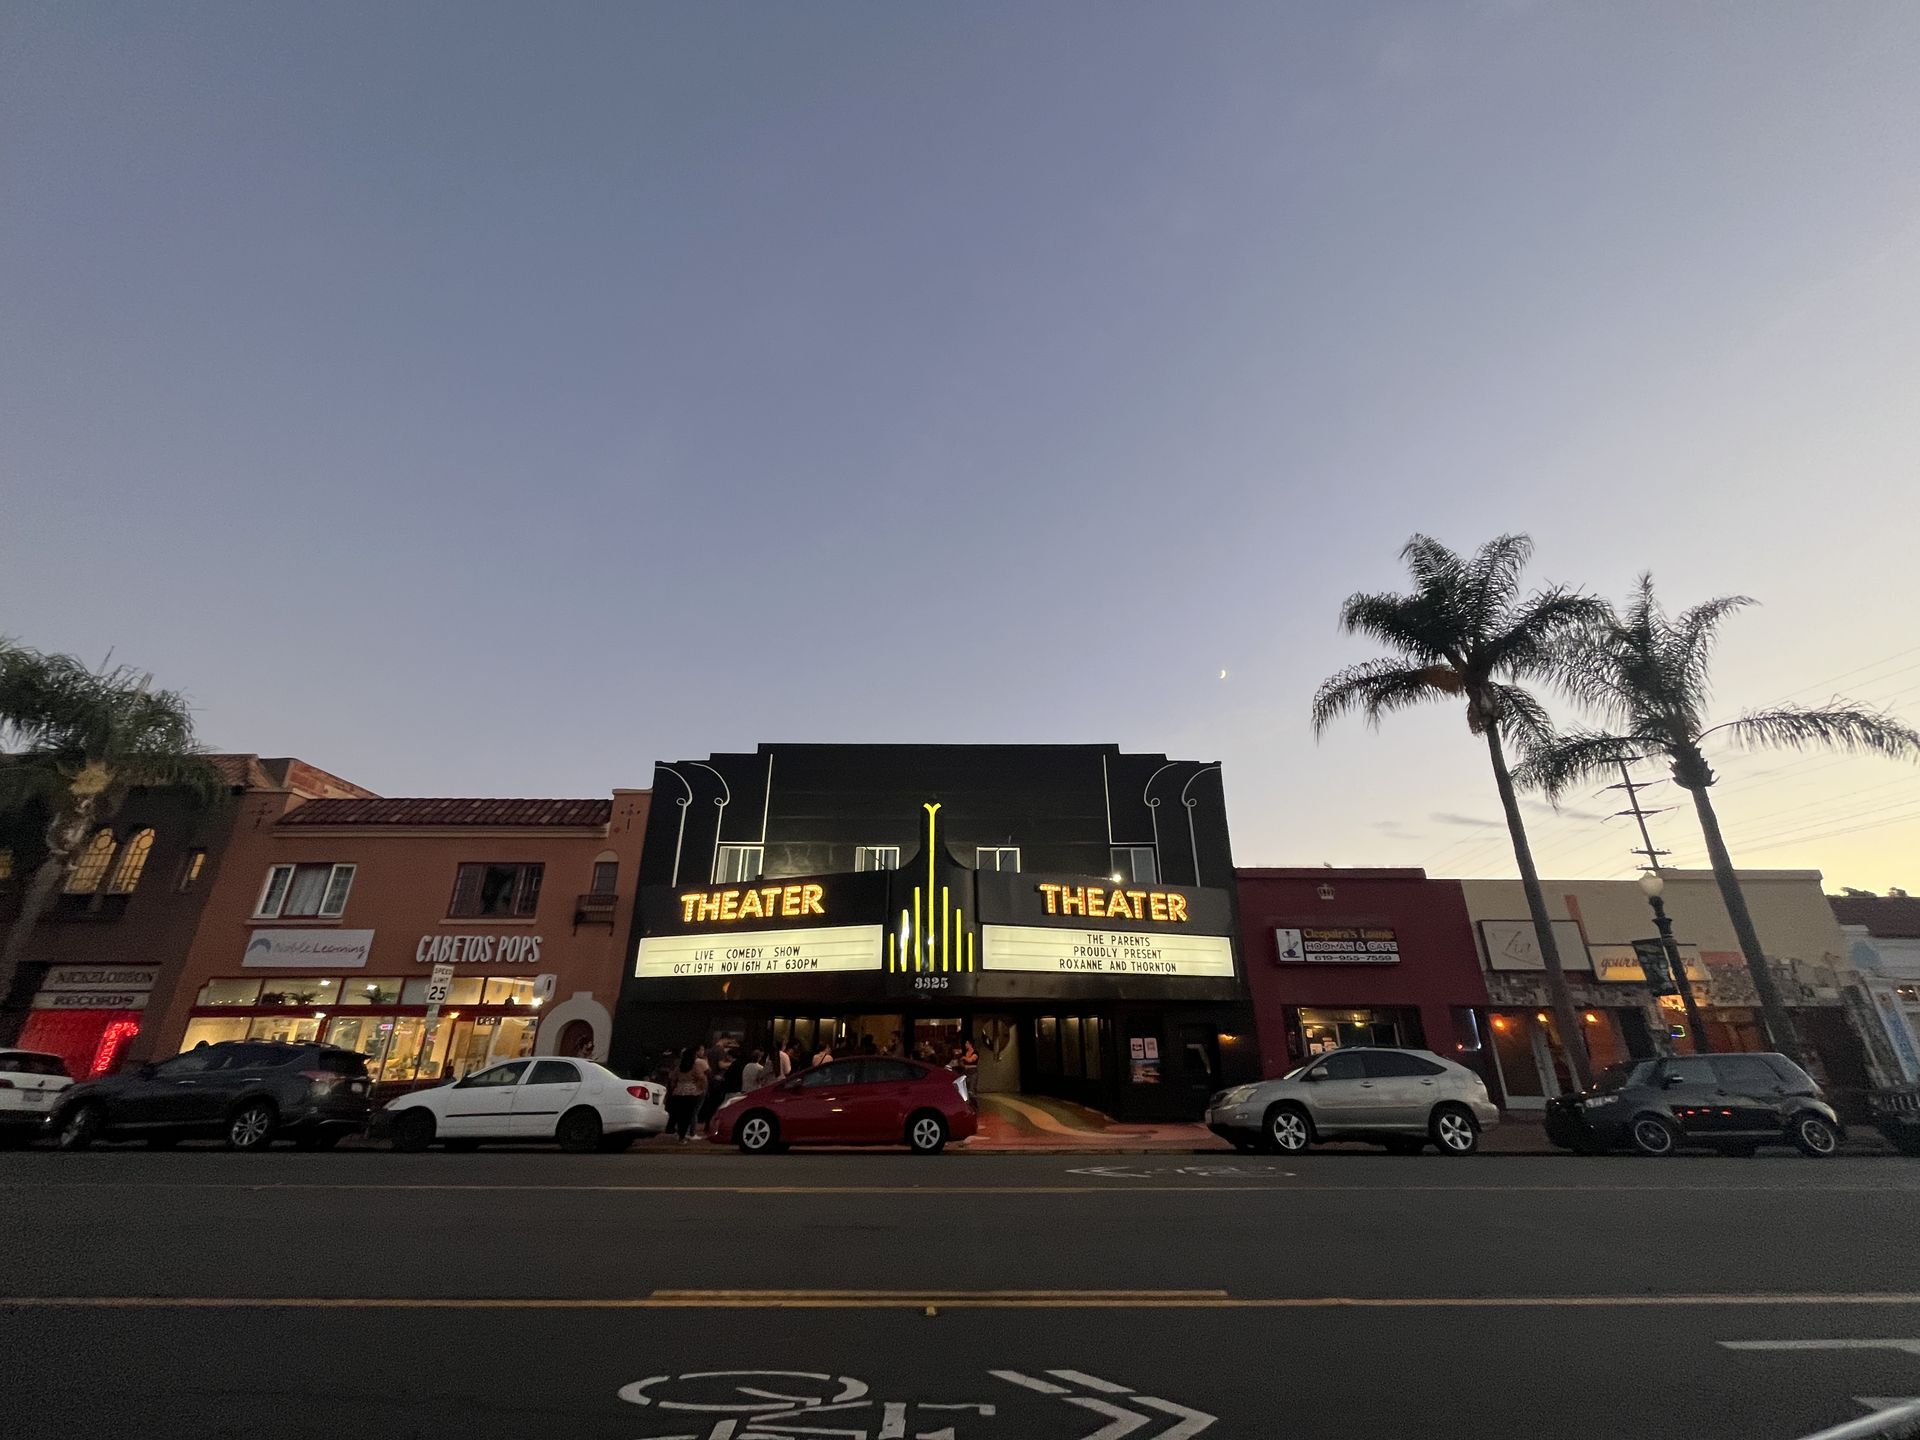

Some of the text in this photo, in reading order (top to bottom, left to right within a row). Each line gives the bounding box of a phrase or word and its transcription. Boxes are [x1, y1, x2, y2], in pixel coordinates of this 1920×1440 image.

[680, 884, 825, 923] THEATER
[1038, 883, 1189, 922] THEATER
[1087, 934, 1151, 947] THE PARENTS
[1304, 941, 1398, 951] HOOKAH & CAFE
[312, 942, 367, 959] Learning
[416, 935, 543, 962] CABETOS POPS
[695, 946, 801, 961] LIVE COMEDY SHOW
[1073, 946, 1162, 960] PROUDLY PRESENT
[434, 967, 453, 976] SPEED
[674, 958, 818, 974] OCT 19TH NOV 16TH AT 630PM
[1059, 958, 1177, 973] ROXANNE AND THORNTON
[433, 976, 449, 984] LIMIT
[914, 976, 949, 990] 3325
[53, 995, 135, 1006] RECORDS
[428, 986, 447, 1001] 25
